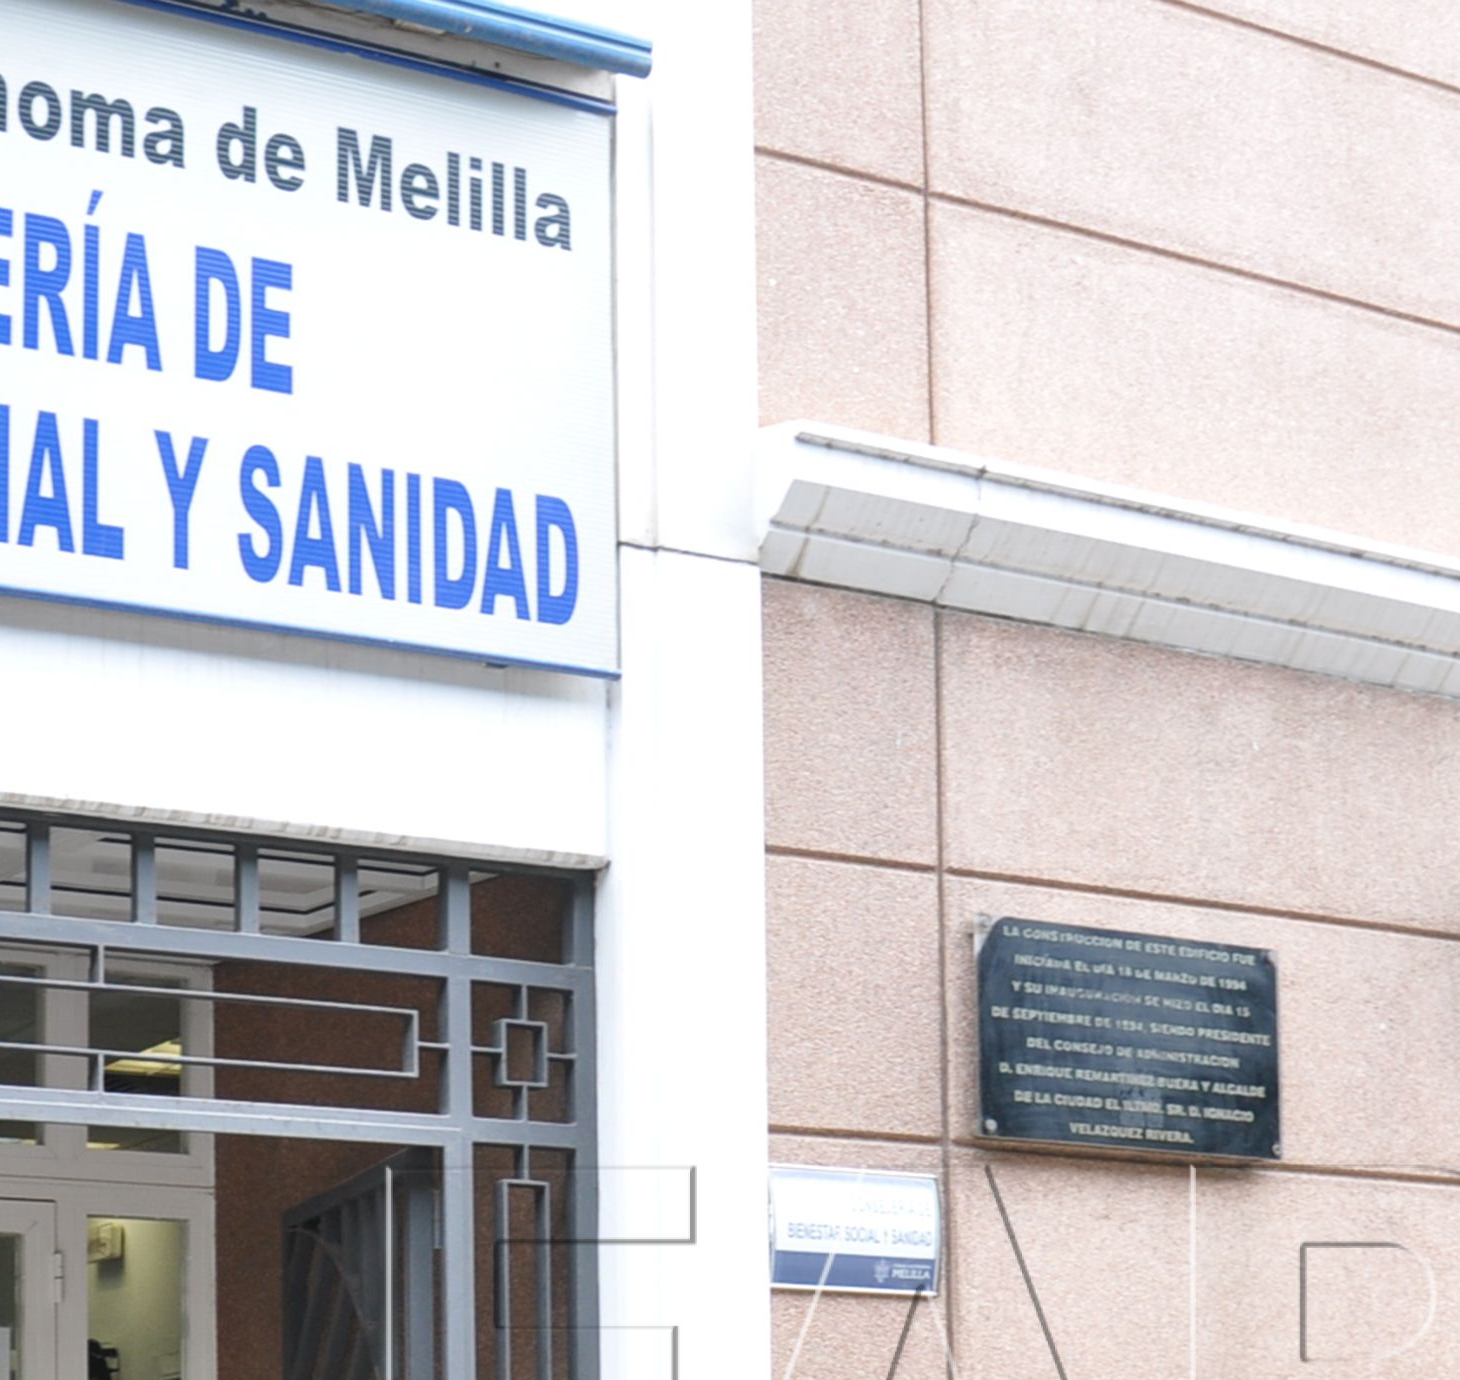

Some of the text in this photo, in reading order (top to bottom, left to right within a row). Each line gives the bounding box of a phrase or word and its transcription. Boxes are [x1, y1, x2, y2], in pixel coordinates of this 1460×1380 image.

[216, 105, 306, 193] de
[336, 126, 573, 251] Melilla
[194, 245, 294, 395] DE
[153, 429, 209, 570] Y
[237, 444, 580, 626] SANIDAD
[1002, 925, 1020, 937] LA
[1125, 940, 1142, 951] DE
[1144, 942, 1176, 956] ESTE
[1178, 945, 1230, 963] EDIFICIO
[1232, 952, 1256, 966] FUE
[1074, 960, 1090, 973] EL
[1134, 969, 1152, 980] DE
[1154, 970, 1198, 985] MARZO
[1199, 975, 1216, 988] DE
[1011, 980, 1022, 992] Y
[1023, 981, 1043, 993] SU
[1144, 995, 1160, 1007] SE
[1163, 998, 1193, 1010] HIZO
[1194, 1001, 1210, 1013] EL
[991, 1005, 1010, 1018] DE
[1012, 1007, 1092, 1028] SEPTIEMBRE
[1094, 1016, 1112, 1029] DE
[1150, 1022, 1195, 1037] SIENDO
[1197, 1026, 1272, 1047] PRESIDENTE
[1026, 1036, 1052, 1050] DEL
[1053, 1039, 1114, 1056] CONSEJO
[1116, 1045, 1133, 1058] DE
[998, 1061, 1014, 1074] D.
[1015, 1062, 1073, 1079] ENRIQUE
[1200, 1080, 1212, 1092] Y
[1212, 1082, 1267, 1098] ALCALDE
[1013, 1089, 1033, 1103] DE
[1034, 1091, 1052, 1104] LA
[1053, 1093, 1103, 1109] CIUDAD
[1105, 1098, 1121, 1111] EL
[1166, 1103, 1187, 1117] SR.
[1188, 1105, 1202, 1118] D.
[1203, 1107, 1255, 1123] IGNACIO
[844, 1225, 881, 1245] SOCIAL
[891, 1228, 933, 1247] SANIDAD
